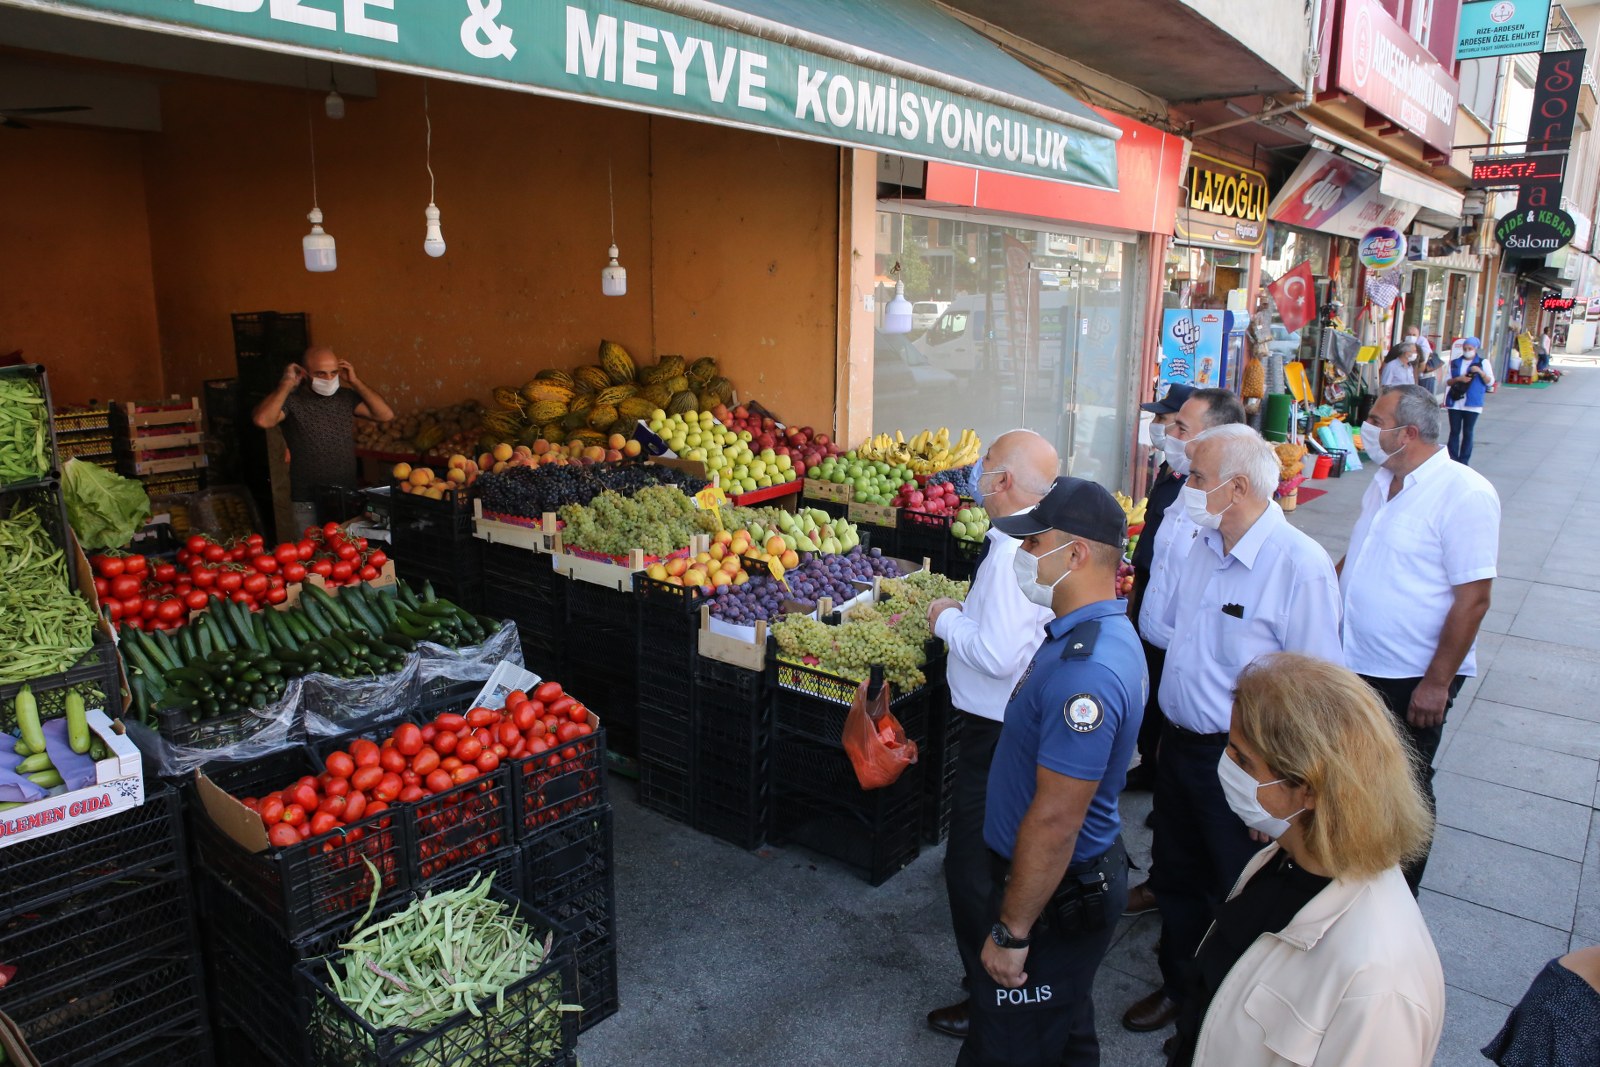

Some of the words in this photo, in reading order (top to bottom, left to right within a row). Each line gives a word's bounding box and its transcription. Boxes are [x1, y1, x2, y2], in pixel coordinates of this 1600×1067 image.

[1460, 36, 1491, 47] ARDEŞEN
[1492, 33, 1510, 43] ÖZEL
[1511, 30, 1541, 40] EHLİYET
[460, 0, 518, 62] &
[565, 6, 769, 111] MEYVE
[796, 65, 1069, 171] KOMİSYONCULUK
[1190, 166, 1268, 222] LAZOĞLU
[1303, 168, 1343, 221] dyo
[1497, 213, 1524, 241] PİDE
[1526, 210, 1535, 223] &
[1537, 210, 1572, 238] KEBAP
[1505, 233, 1560, 249] Salonu
[69, 794, 112, 817] GIDA
